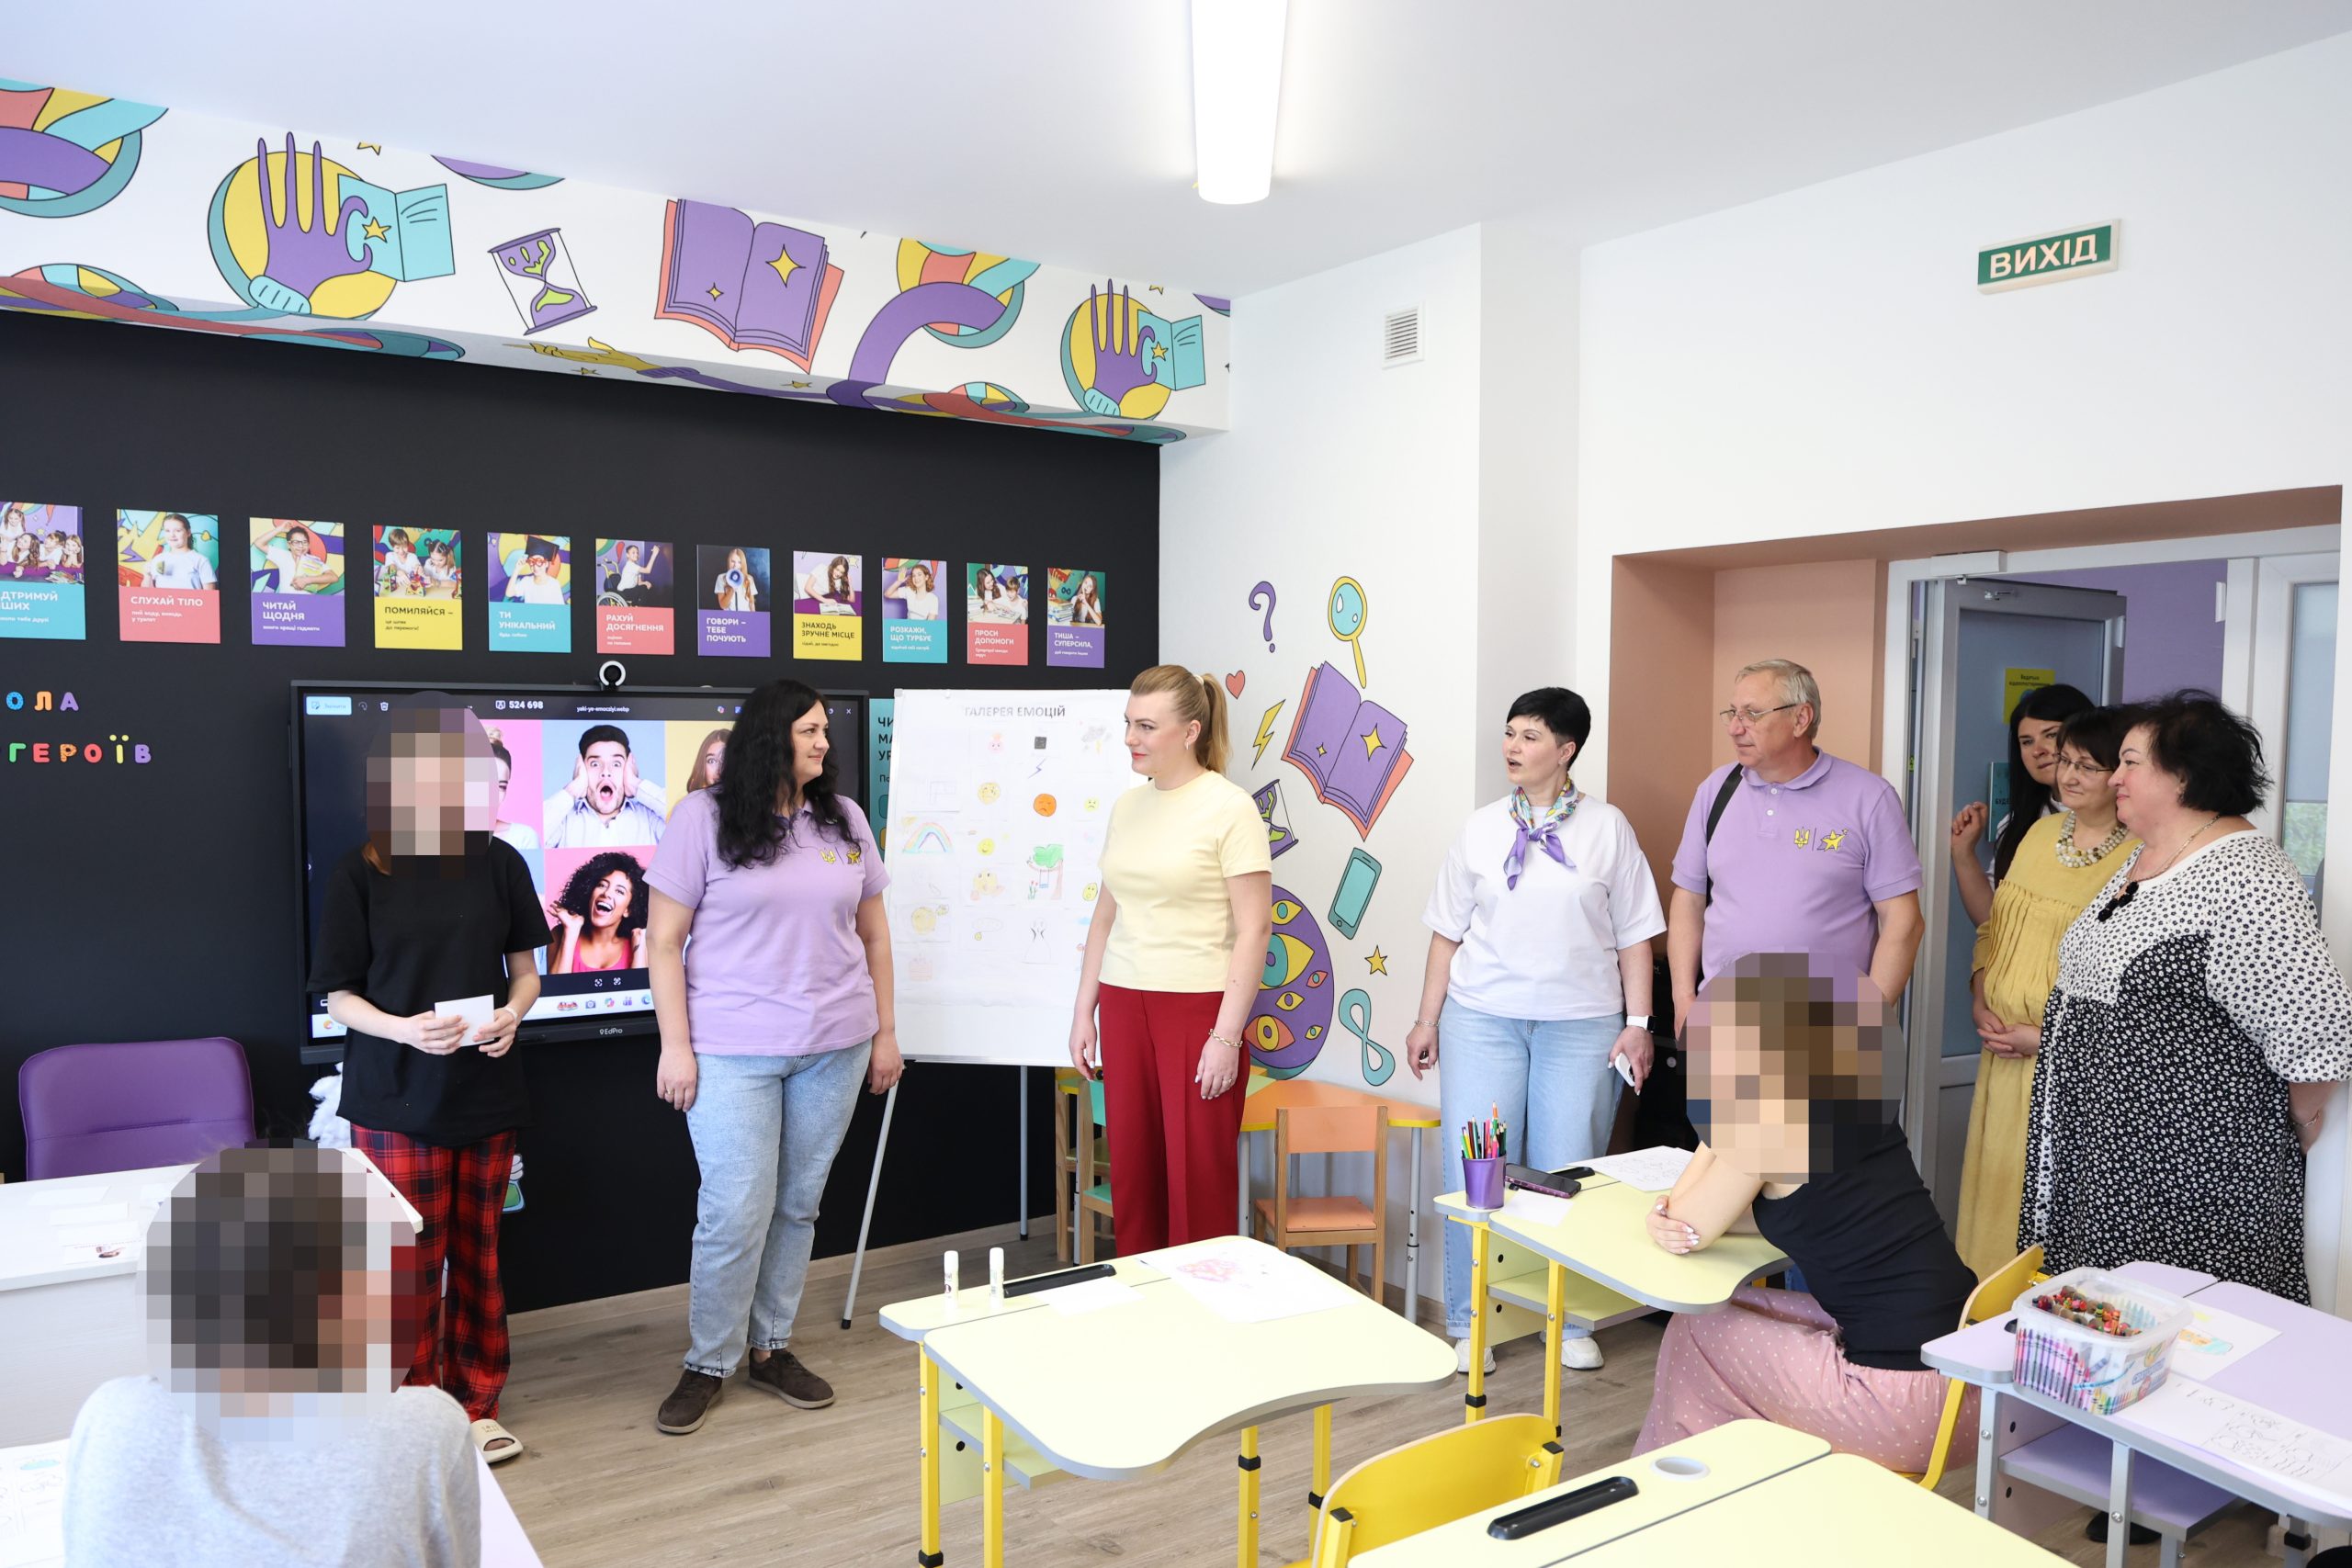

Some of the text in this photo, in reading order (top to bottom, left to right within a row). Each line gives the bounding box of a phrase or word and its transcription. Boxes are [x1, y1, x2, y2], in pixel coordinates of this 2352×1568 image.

[1990, 234, 2098, 279] ВИХІД
[130, 595, 203, 606] СЛУХАЙ ТІЛО
[262, 601, 296, 610] ЧИТАЙ
[384, 606, 446, 615] ПОМИЛЯЙСЯ
[499, 611, 512, 619] ТИ
[263, 612, 305, 621] ЩОДНЯ
[606, 613, 634, 622] РАХУЙ
[499, 620, 556, 631] УНІКАЛЬНИЙ
[706, 617, 739, 626] ГОВОРИ
[606, 623, 664, 633] ДОСЯГНЕННЯ
[706, 626, 727, 634] ТЕБЕ
[801, 622, 837, 631] ЗНАХОДЬ
[889, 626, 927, 634] РОЗКАЖИ,
[707, 634, 747, 643] ПОЧУЮТЬ
[801, 629, 855, 640] ЗРУЧНЕ МІСЦЕ
[890, 634, 905, 643] ЩО
[975, 637, 1014, 645] ДОПОМОГИ
[6, 691, 79, 711] ОЛА
[509, 701, 544, 709] 524 698
[965, 705, 1066, 718] ГАЛЕРЕЯ ЕМОЦІЙ
[9, 734, 152, 764] ГЕРОЇВ
[605, 1027, 623, 1035] EdPro
